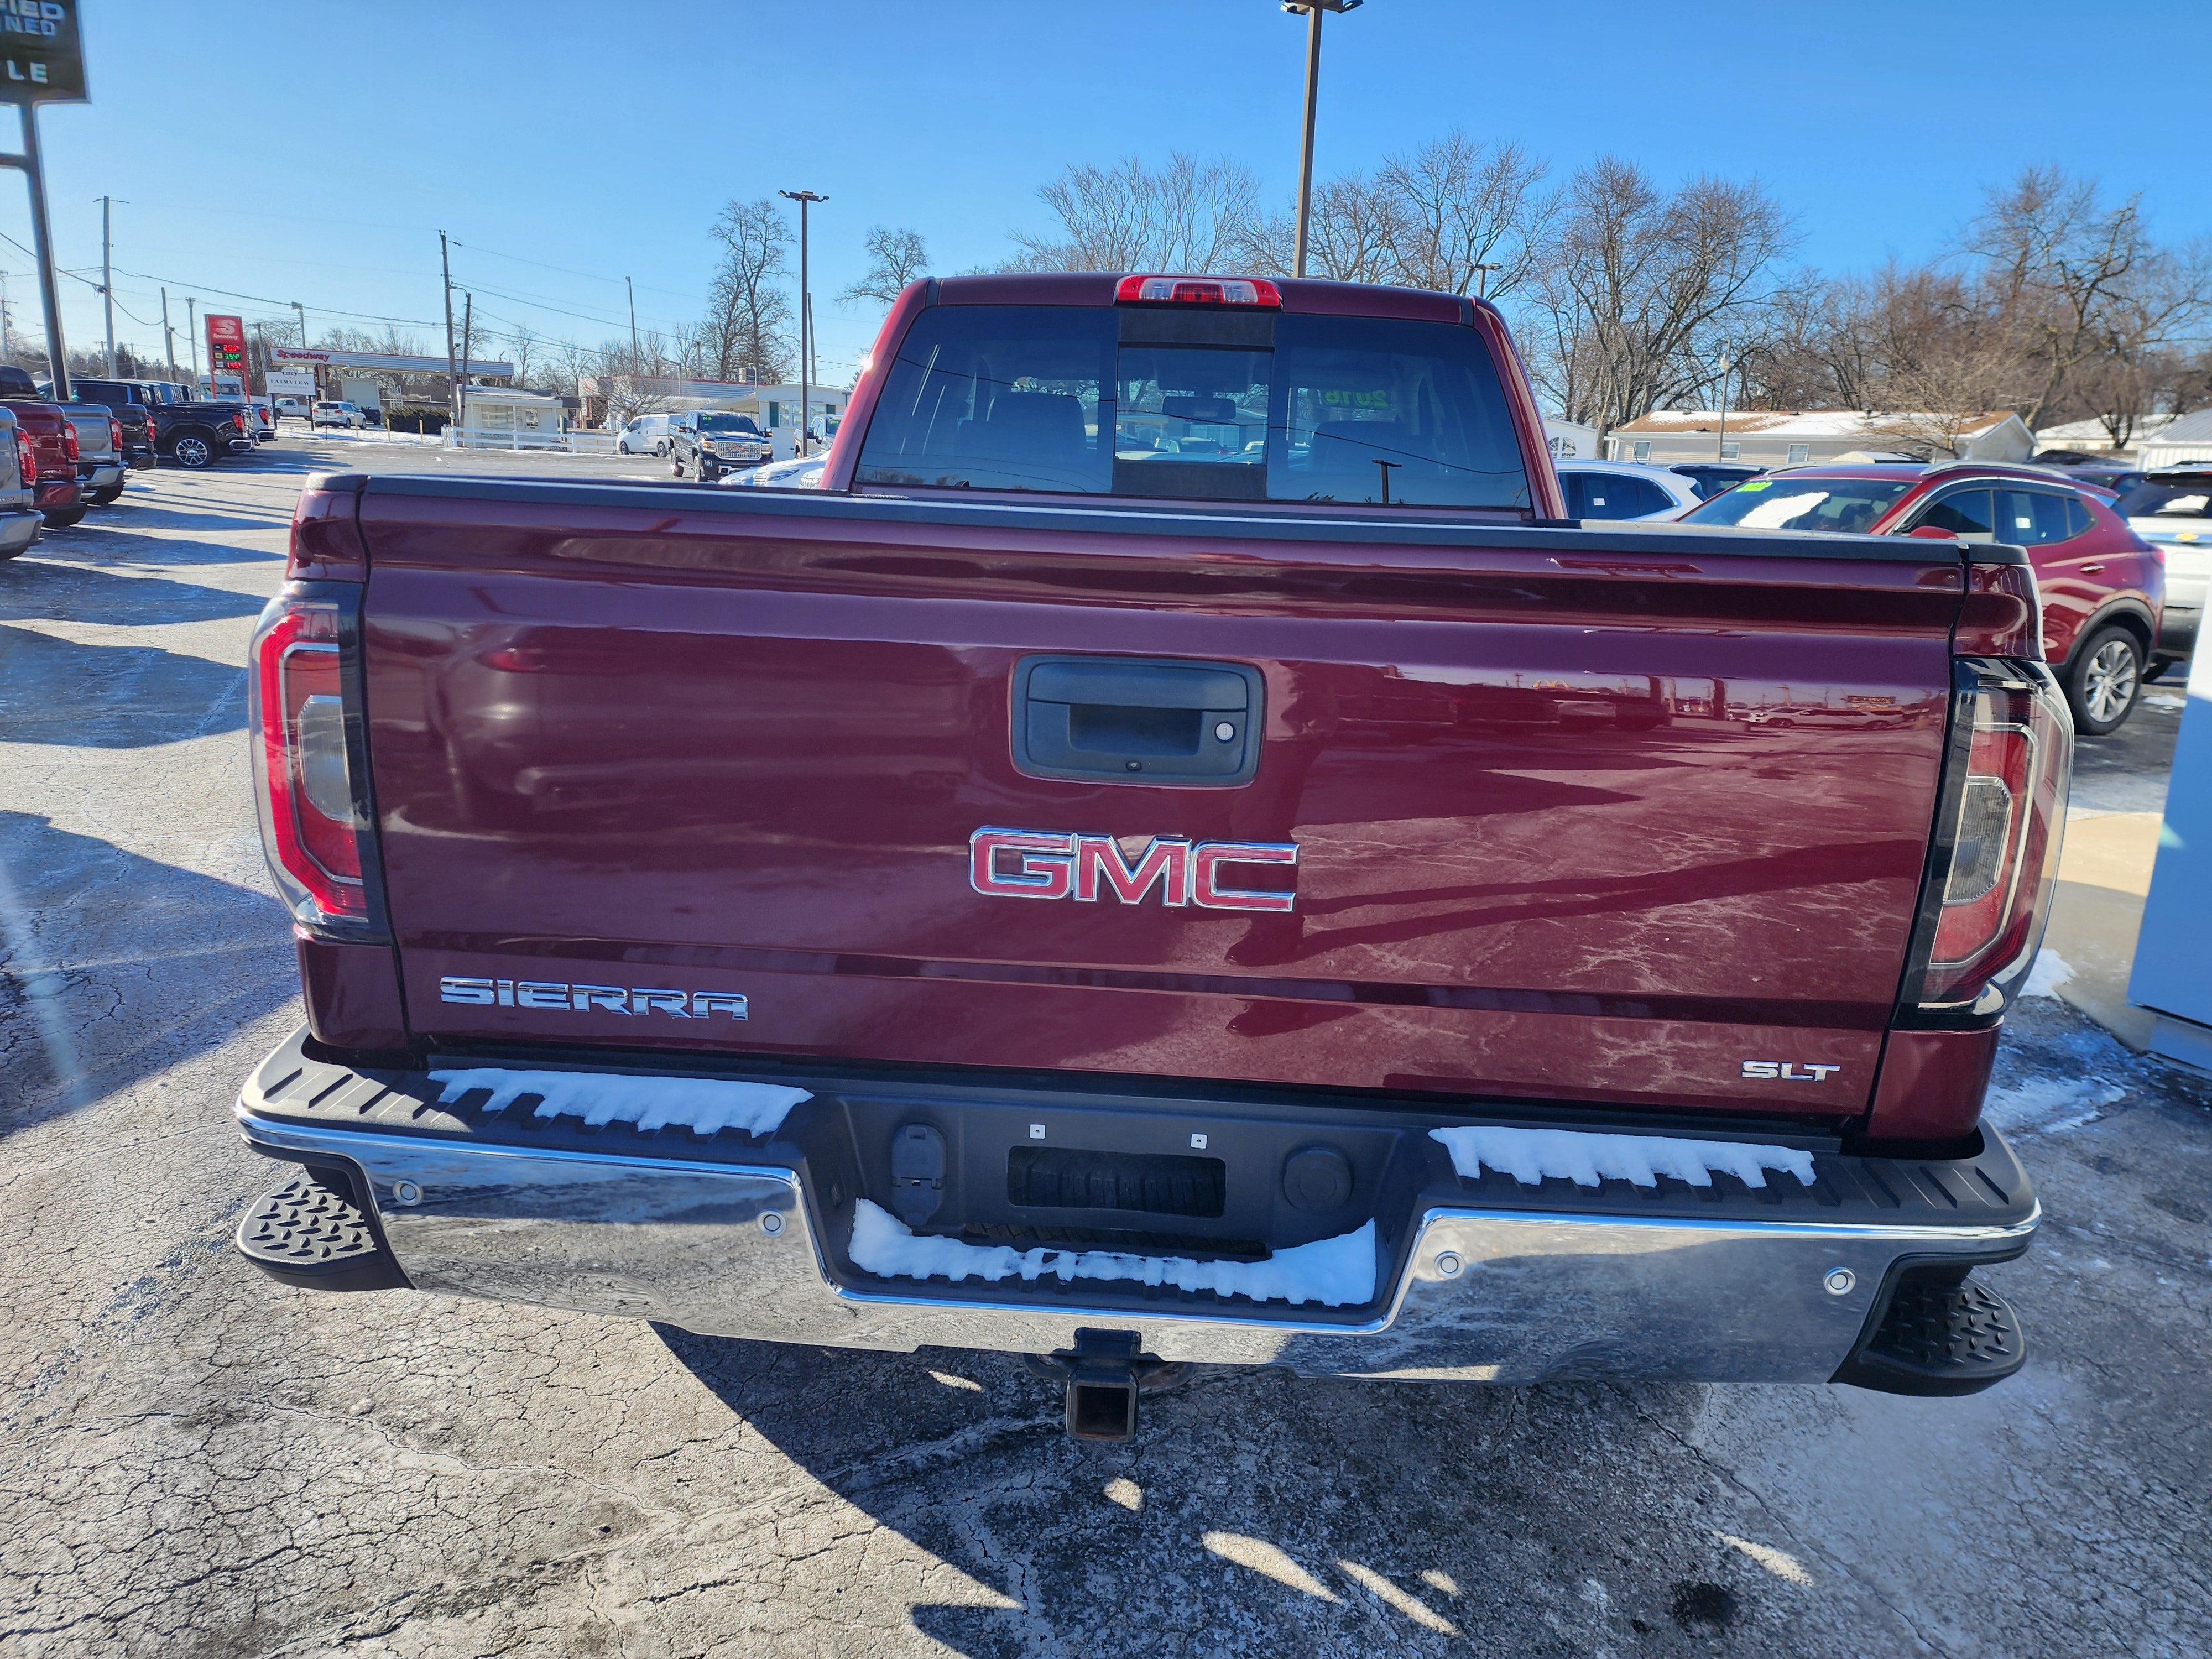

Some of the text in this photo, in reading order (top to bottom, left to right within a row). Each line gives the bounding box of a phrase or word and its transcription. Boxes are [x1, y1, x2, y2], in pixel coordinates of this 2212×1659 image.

[277, 349, 330, 362] Speedway
[969, 825, 1300, 912] GMC
[440, 975, 749, 1021] SIERRA
[1741, 1060, 1841, 1082] SLT
